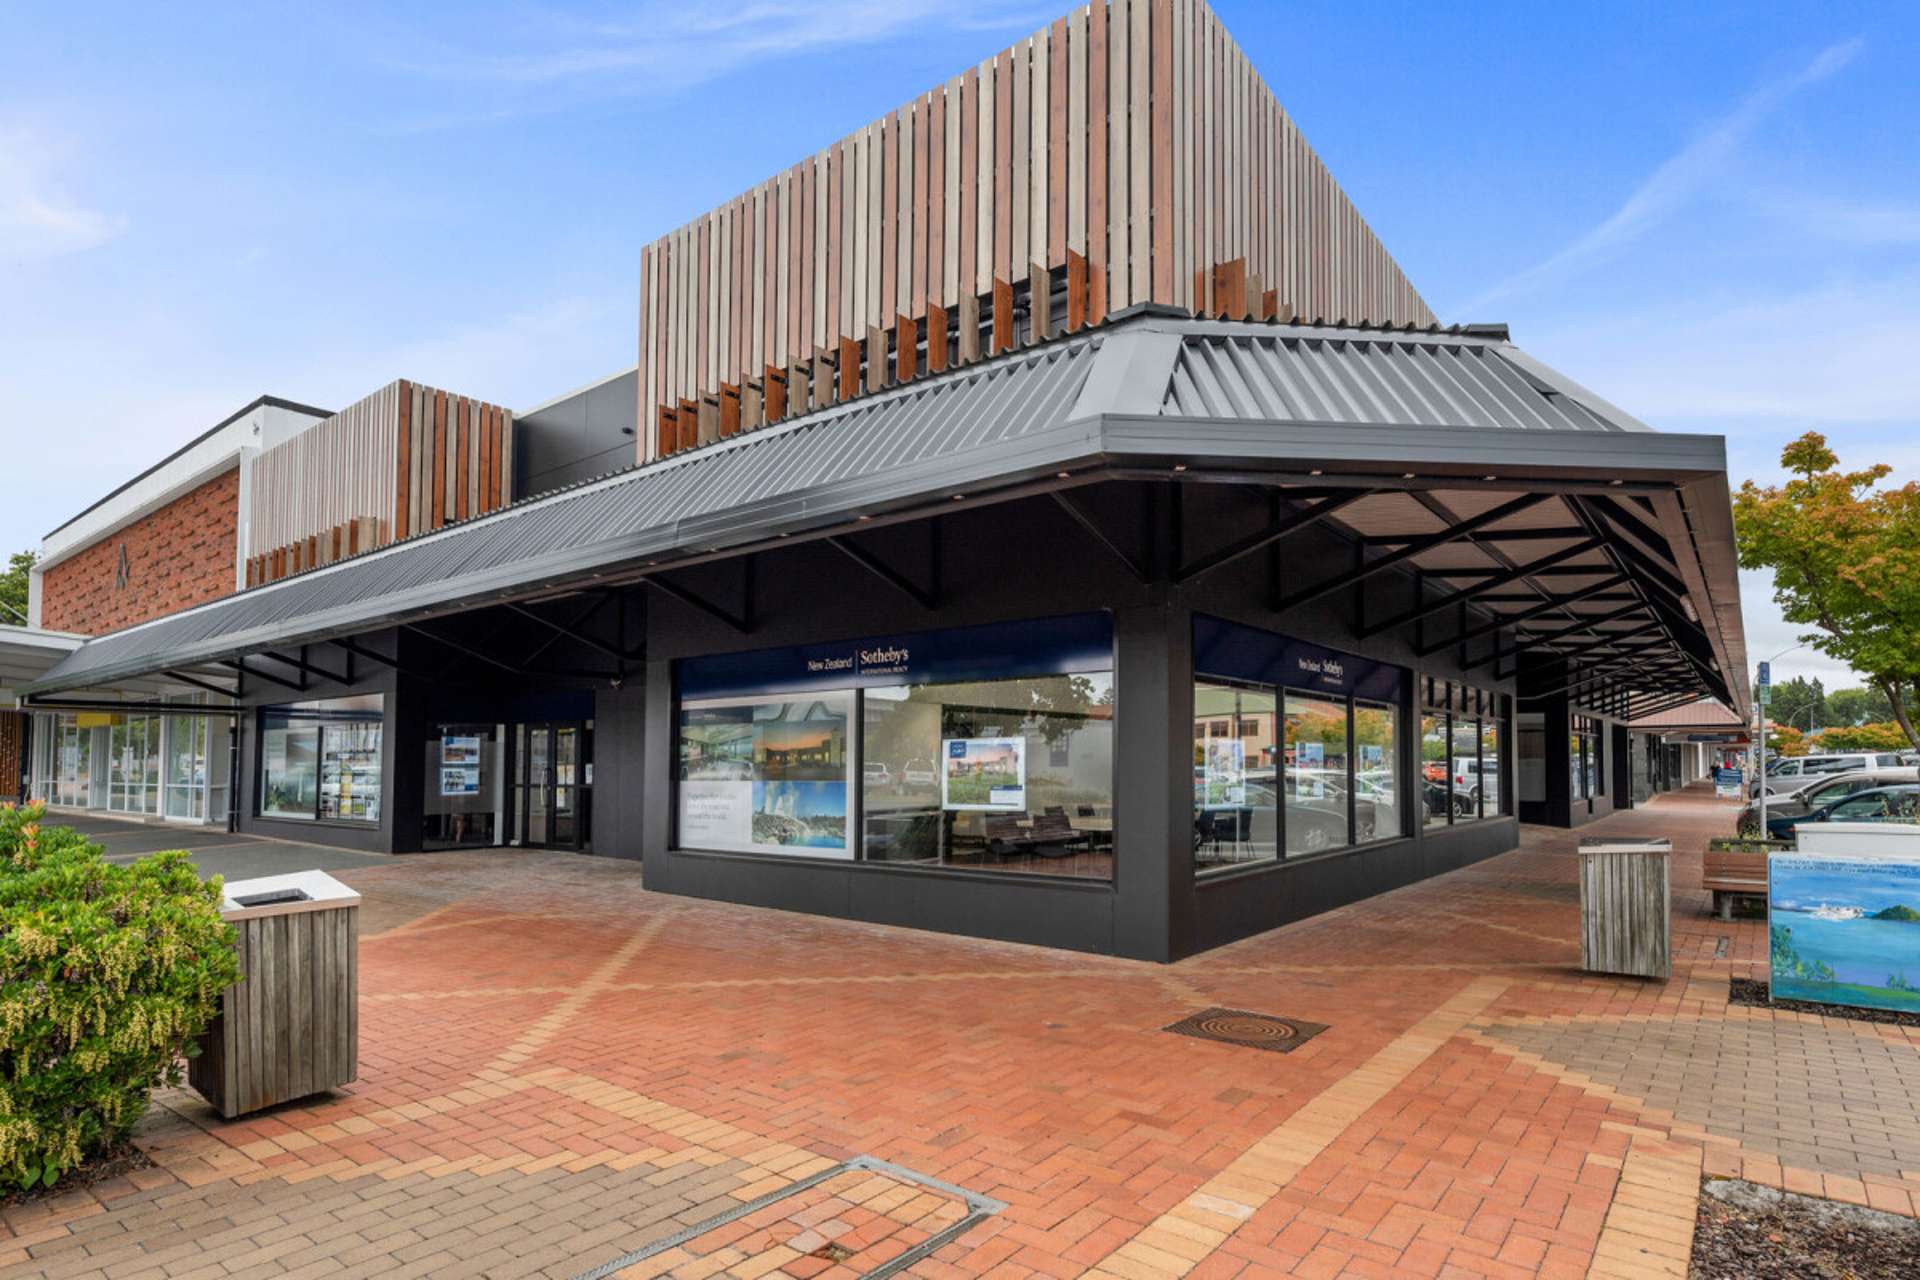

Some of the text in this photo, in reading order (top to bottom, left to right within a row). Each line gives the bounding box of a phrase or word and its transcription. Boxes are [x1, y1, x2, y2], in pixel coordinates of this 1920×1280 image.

[808, 660, 823, 671] New
[824, 657, 853, 670] Zealand
[860, 646, 909, 665] Sotheby's
